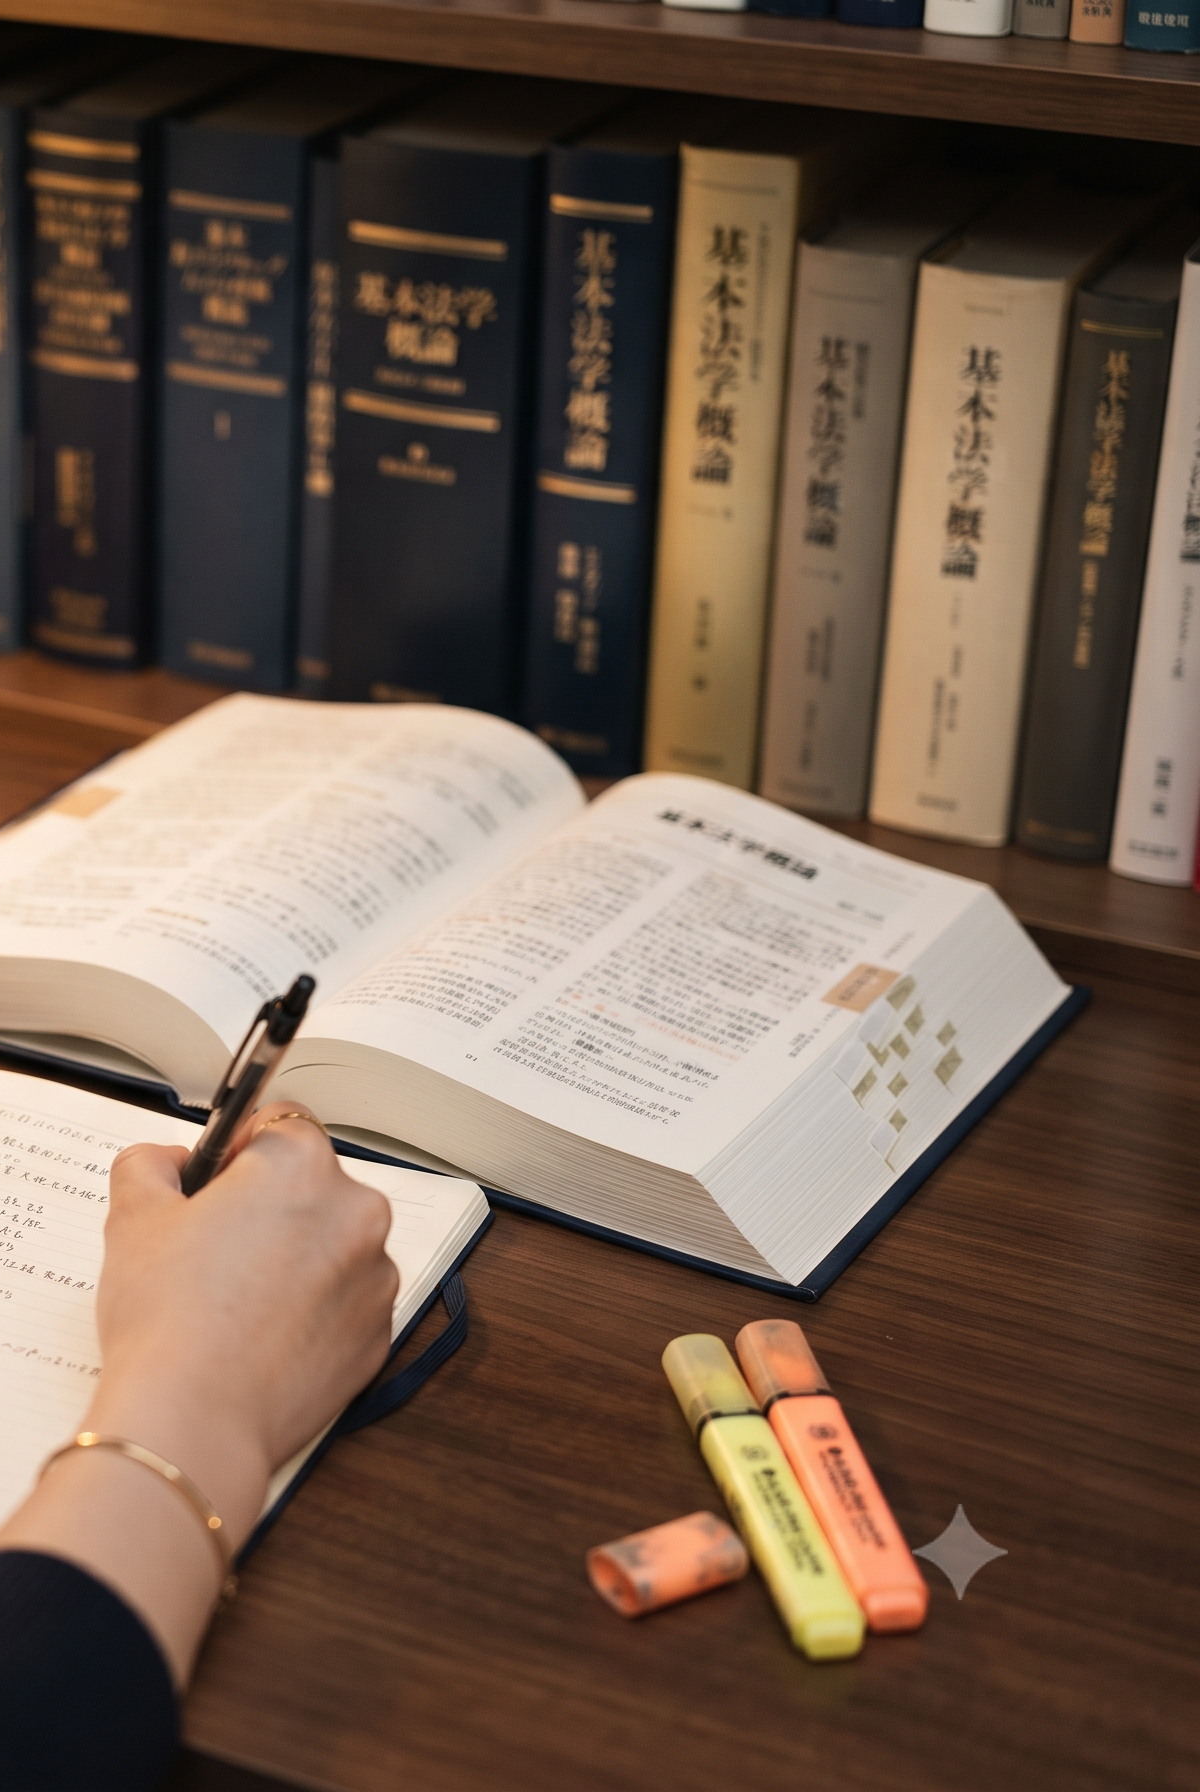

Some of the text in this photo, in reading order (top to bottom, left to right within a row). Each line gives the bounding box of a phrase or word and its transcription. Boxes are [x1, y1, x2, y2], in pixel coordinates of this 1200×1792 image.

[692, 223, 750, 485] 基本法学概論
[941, 344, 1002, 580] 基本法学概論
